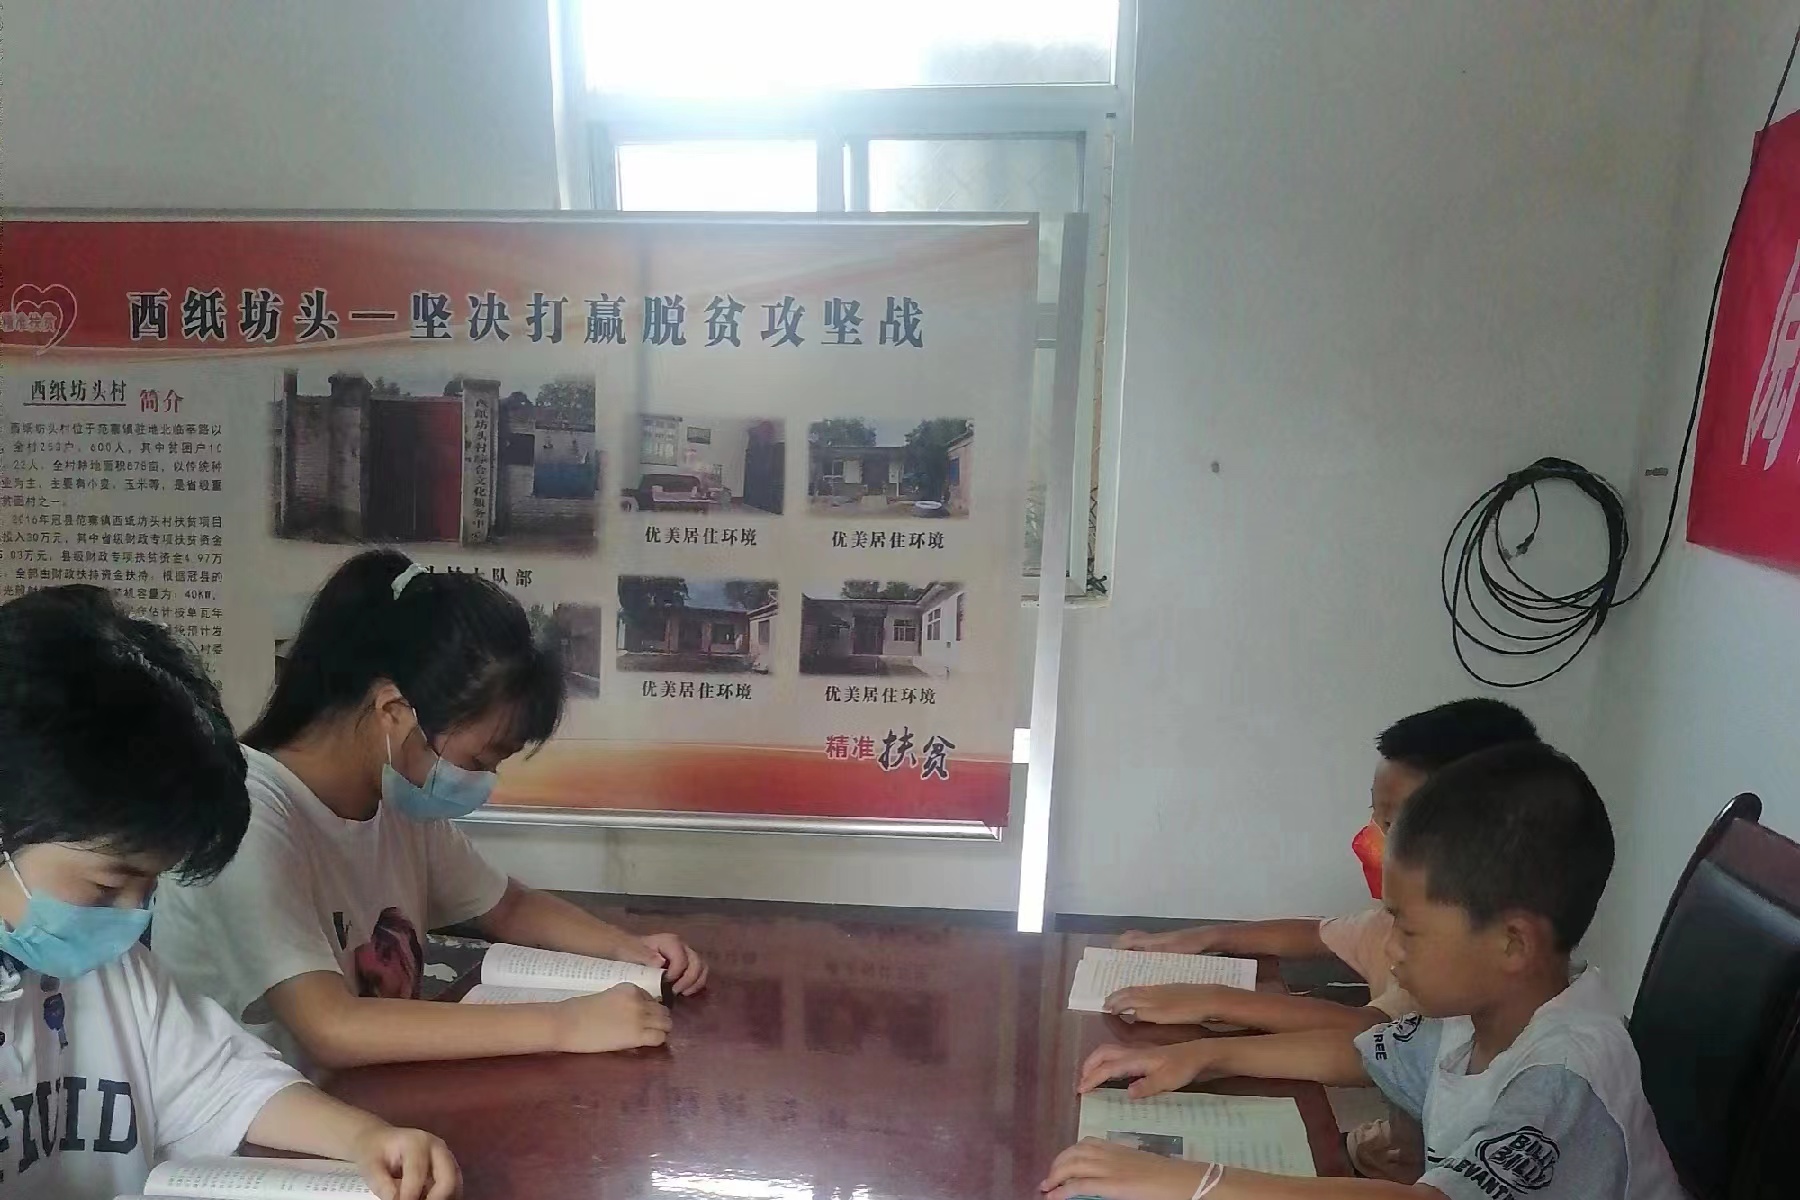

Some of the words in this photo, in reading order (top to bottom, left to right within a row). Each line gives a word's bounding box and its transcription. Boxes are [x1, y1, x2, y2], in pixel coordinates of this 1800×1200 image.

[31, 379, 127, 402] 西纸坊头村
[139, 389, 185, 413] 简介
[645, 526, 757, 547] 优美居住环境
[831, 531, 945, 550] 优美居住环境
[642, 680, 752, 701] 优美居住环境
[824, 685, 936, 706] 优美居住环境
